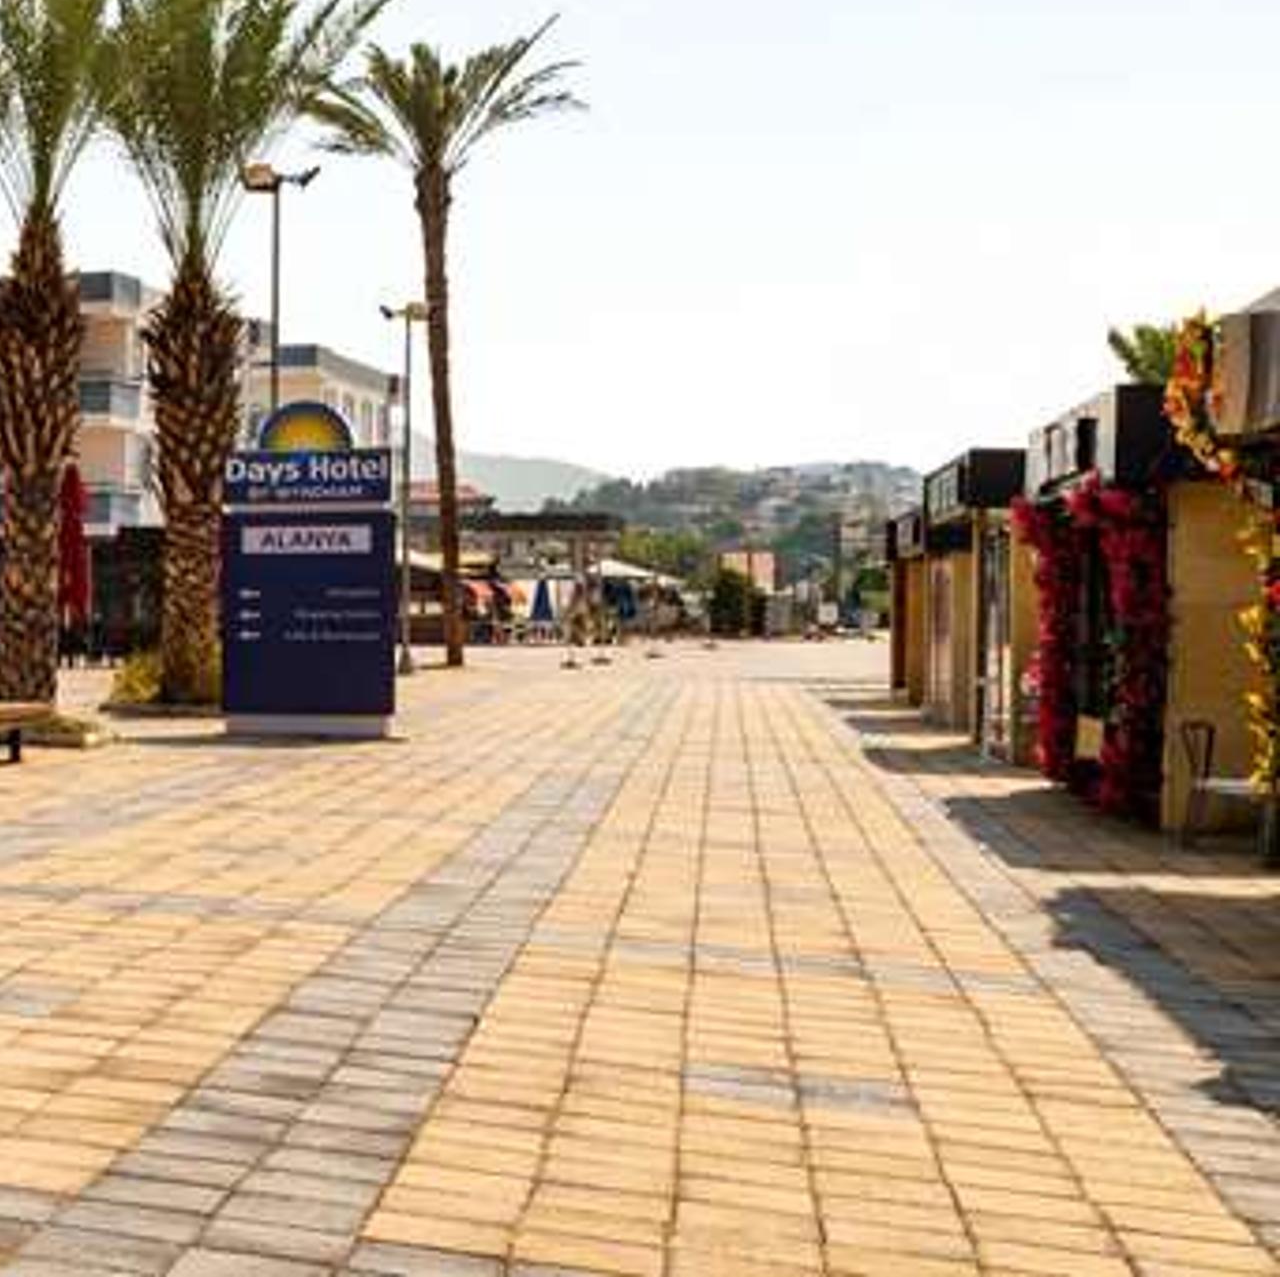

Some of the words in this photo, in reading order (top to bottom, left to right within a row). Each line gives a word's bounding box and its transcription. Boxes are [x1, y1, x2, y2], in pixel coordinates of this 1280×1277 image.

[226, 457, 301, 486] Days
[308, 454, 389, 482] Hotel
[260, 530, 352, 548] ALANYA
